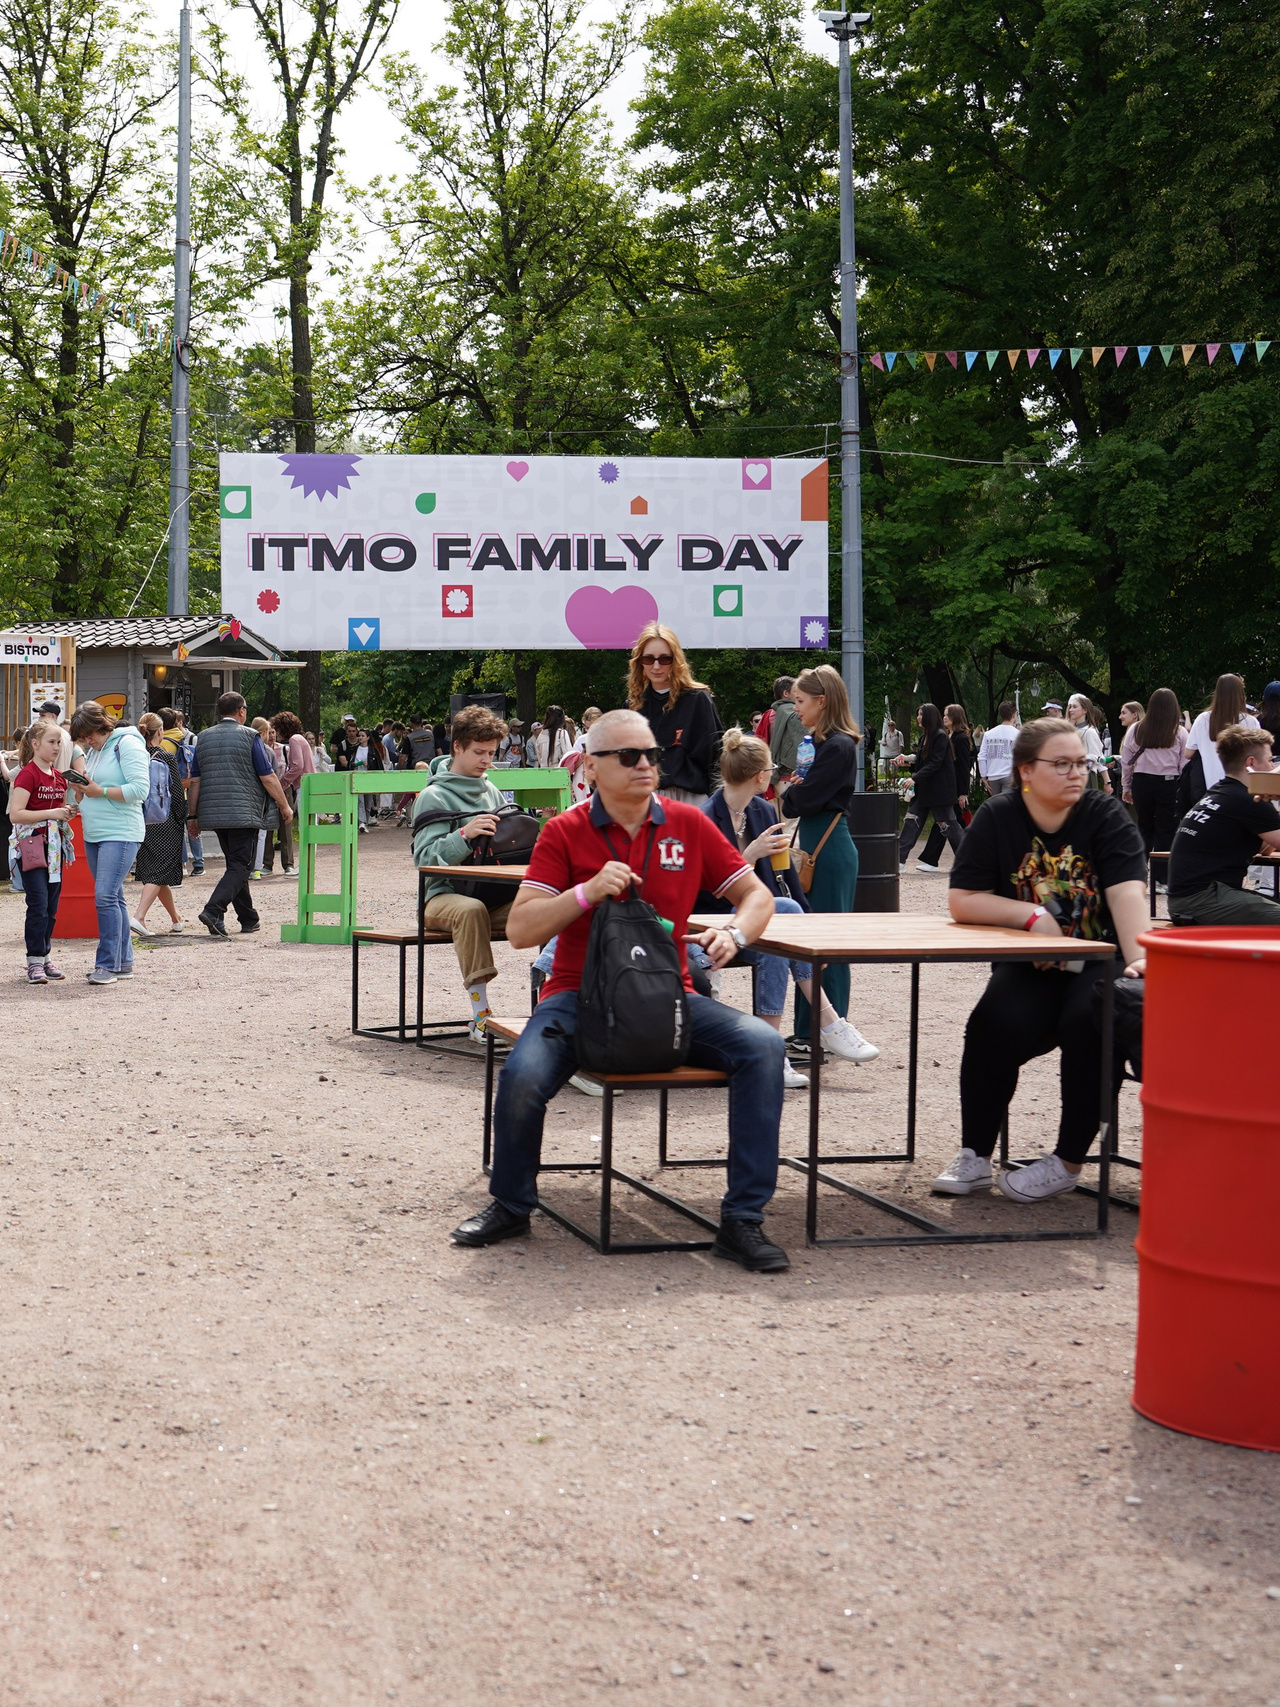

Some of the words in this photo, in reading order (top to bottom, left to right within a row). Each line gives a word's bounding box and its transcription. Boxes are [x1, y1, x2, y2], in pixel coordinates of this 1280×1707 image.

[251, 537, 417, 572] ITMO
[437, 537, 664, 572] FAMILY
[681, 538, 804, 572] DAY
[4, 644, 50, 656] BISTRO
[658, 843, 685, 866] LC
[673, 999, 683, 1050] HEAD
